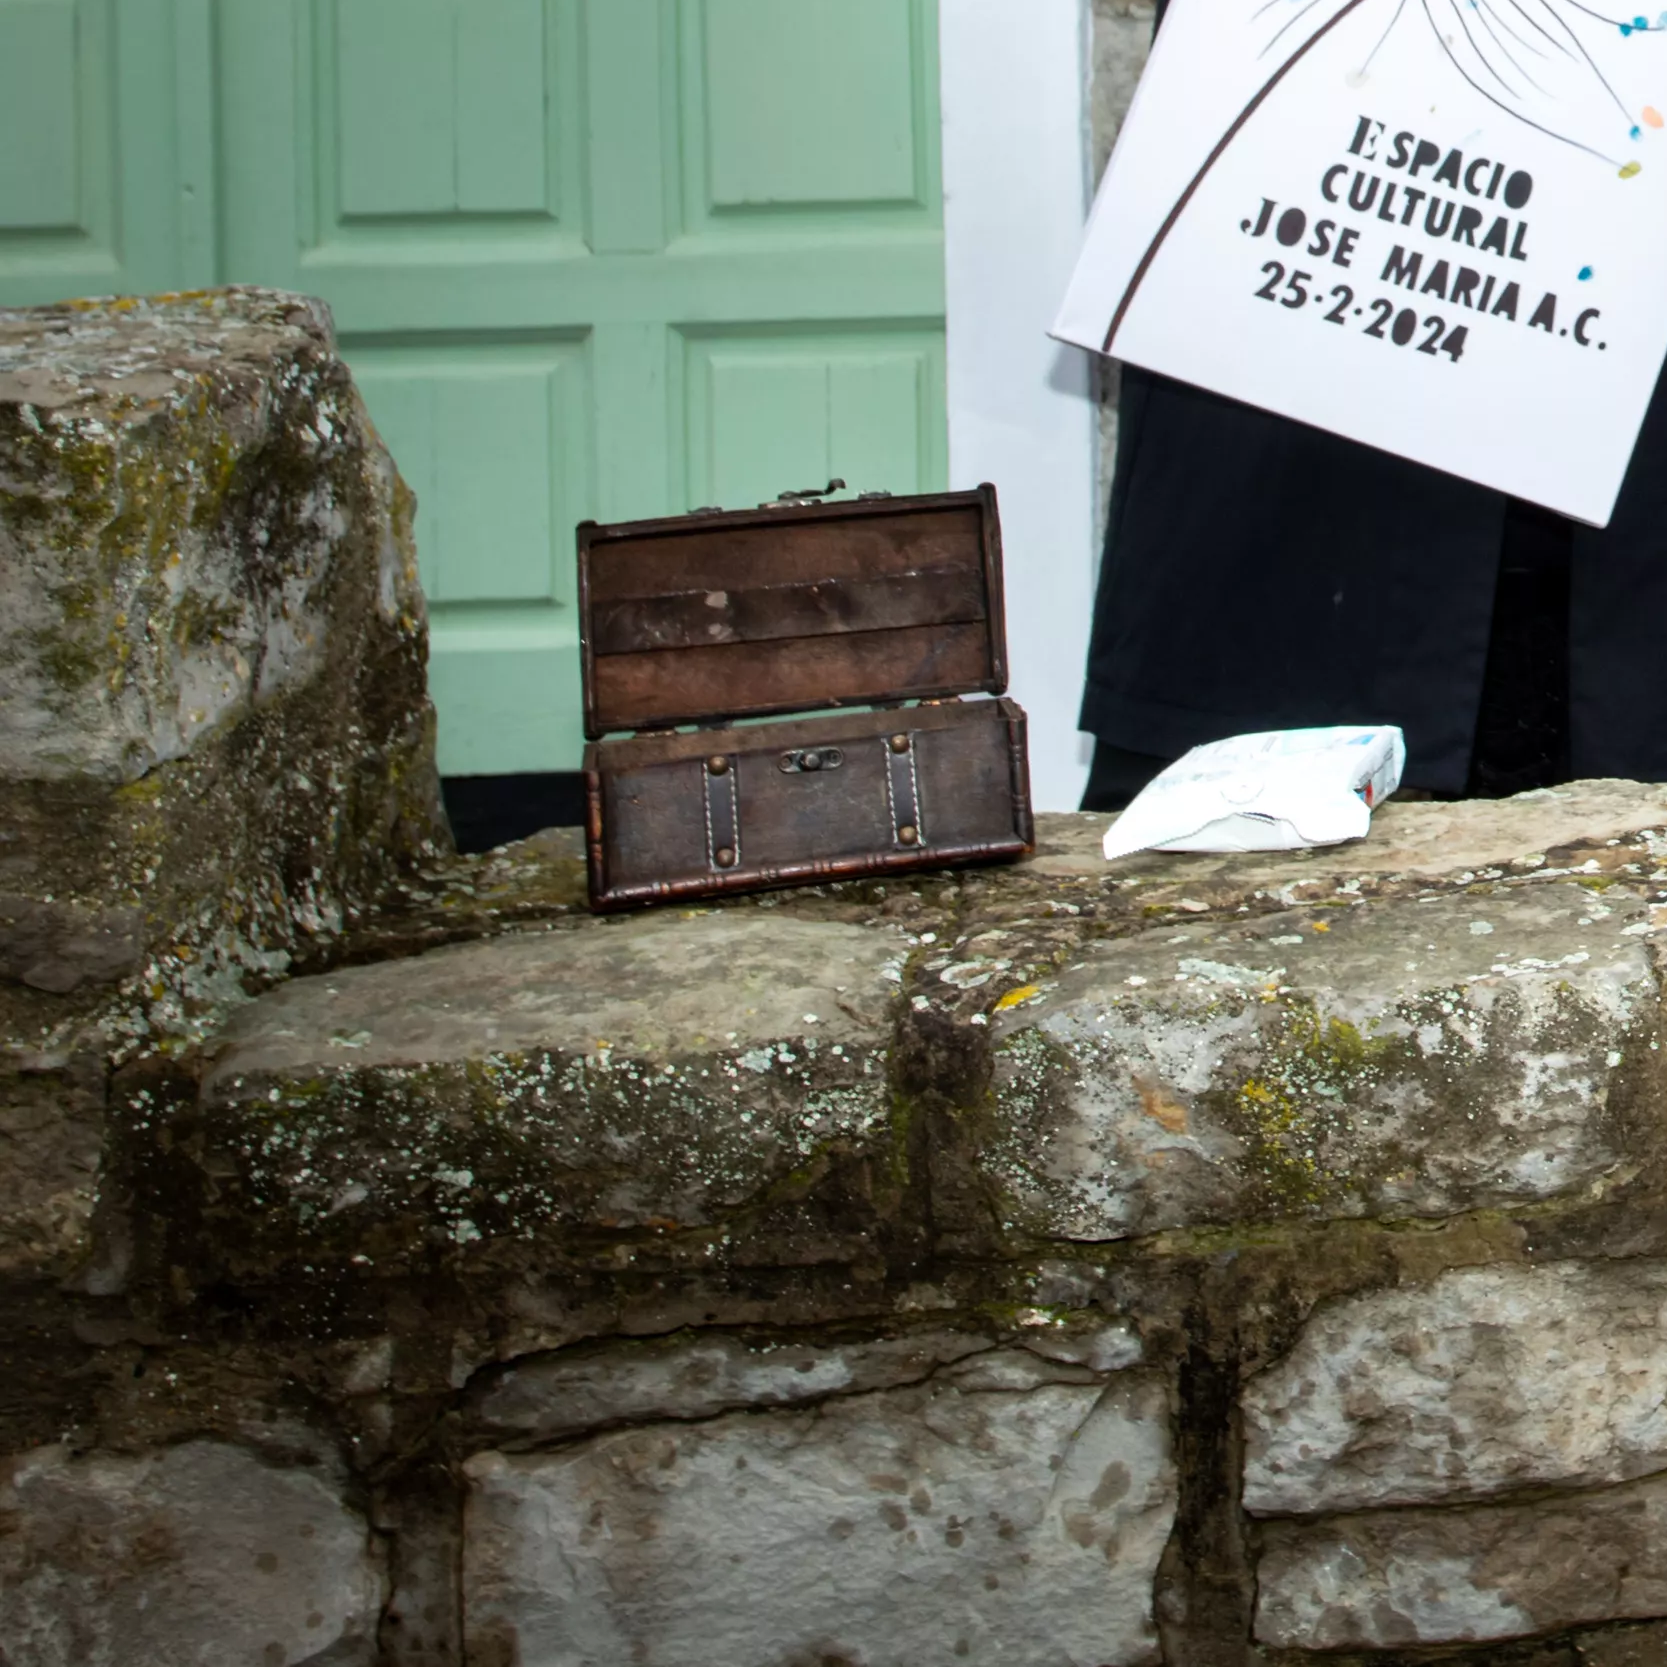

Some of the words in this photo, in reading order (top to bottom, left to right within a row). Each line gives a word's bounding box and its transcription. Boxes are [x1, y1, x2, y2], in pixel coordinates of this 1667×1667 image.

[1346, 114, 1533, 209] ESPACIO
[1240, 197, 1361, 268] JOSE
[1380, 244, 1521, 322] MARIA
[1320, 163, 1528, 261] CULTURAL
